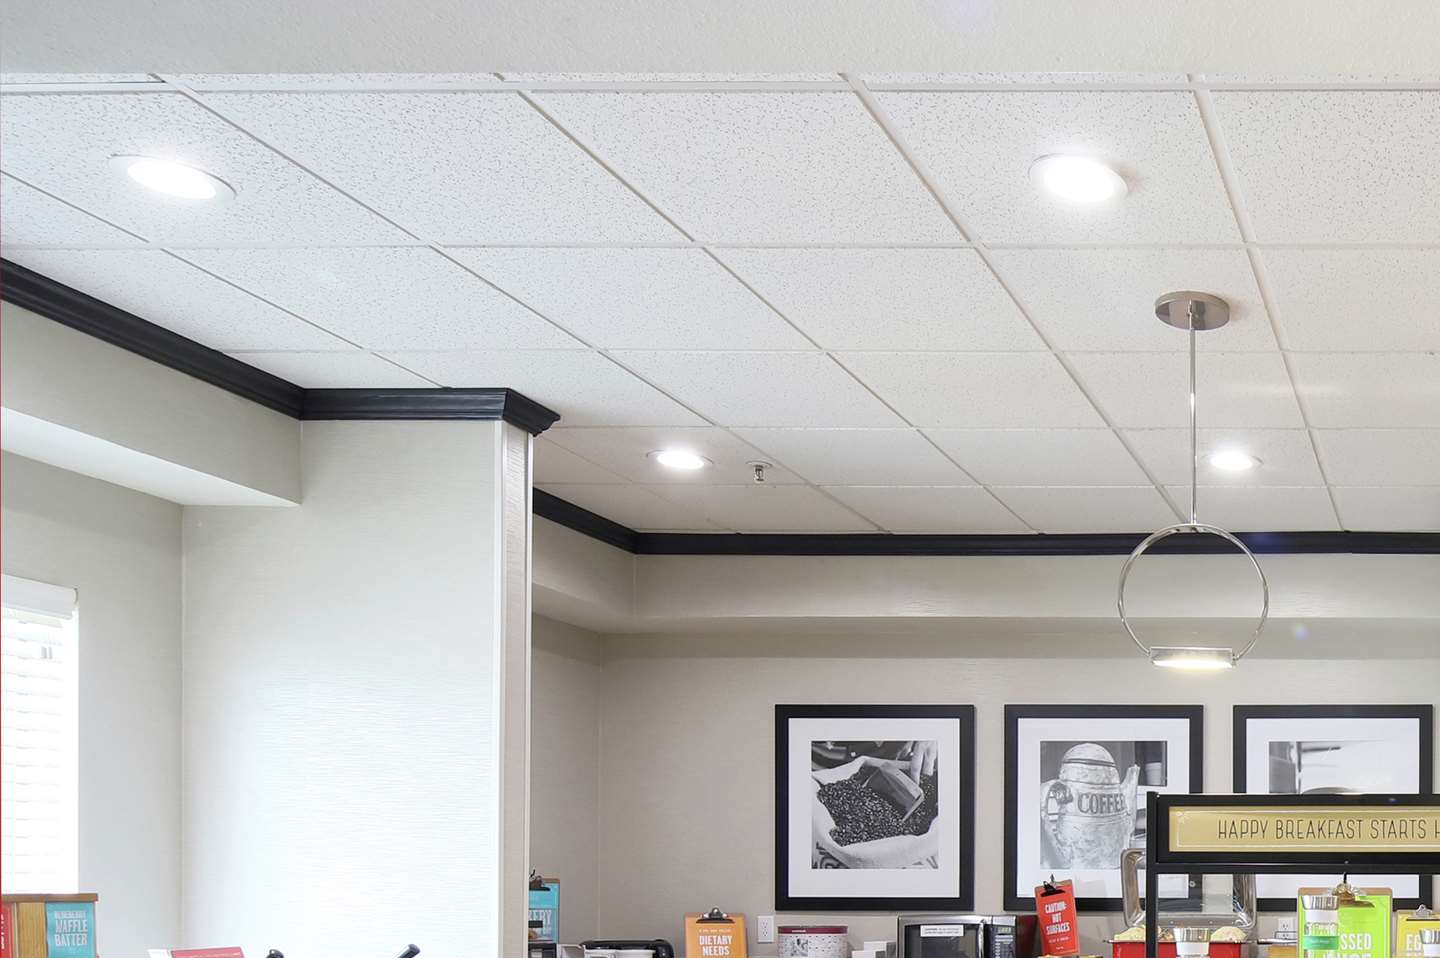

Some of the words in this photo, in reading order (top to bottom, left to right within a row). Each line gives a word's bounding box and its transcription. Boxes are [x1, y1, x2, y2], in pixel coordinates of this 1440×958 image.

[1078, 792, 1125, 814] COFFEE
[1218, 819, 1269, 840] HAPPY
[1275, 819, 1363, 840] BREAKFAST
[1370, 819, 1427, 840] STARTS
[55, 918, 88, 933] WAFFLE
[54, 933, 88, 948] BATTER
[699, 935, 733, 945] DIETARY
[702, 945, 730, 957] NEEDS
